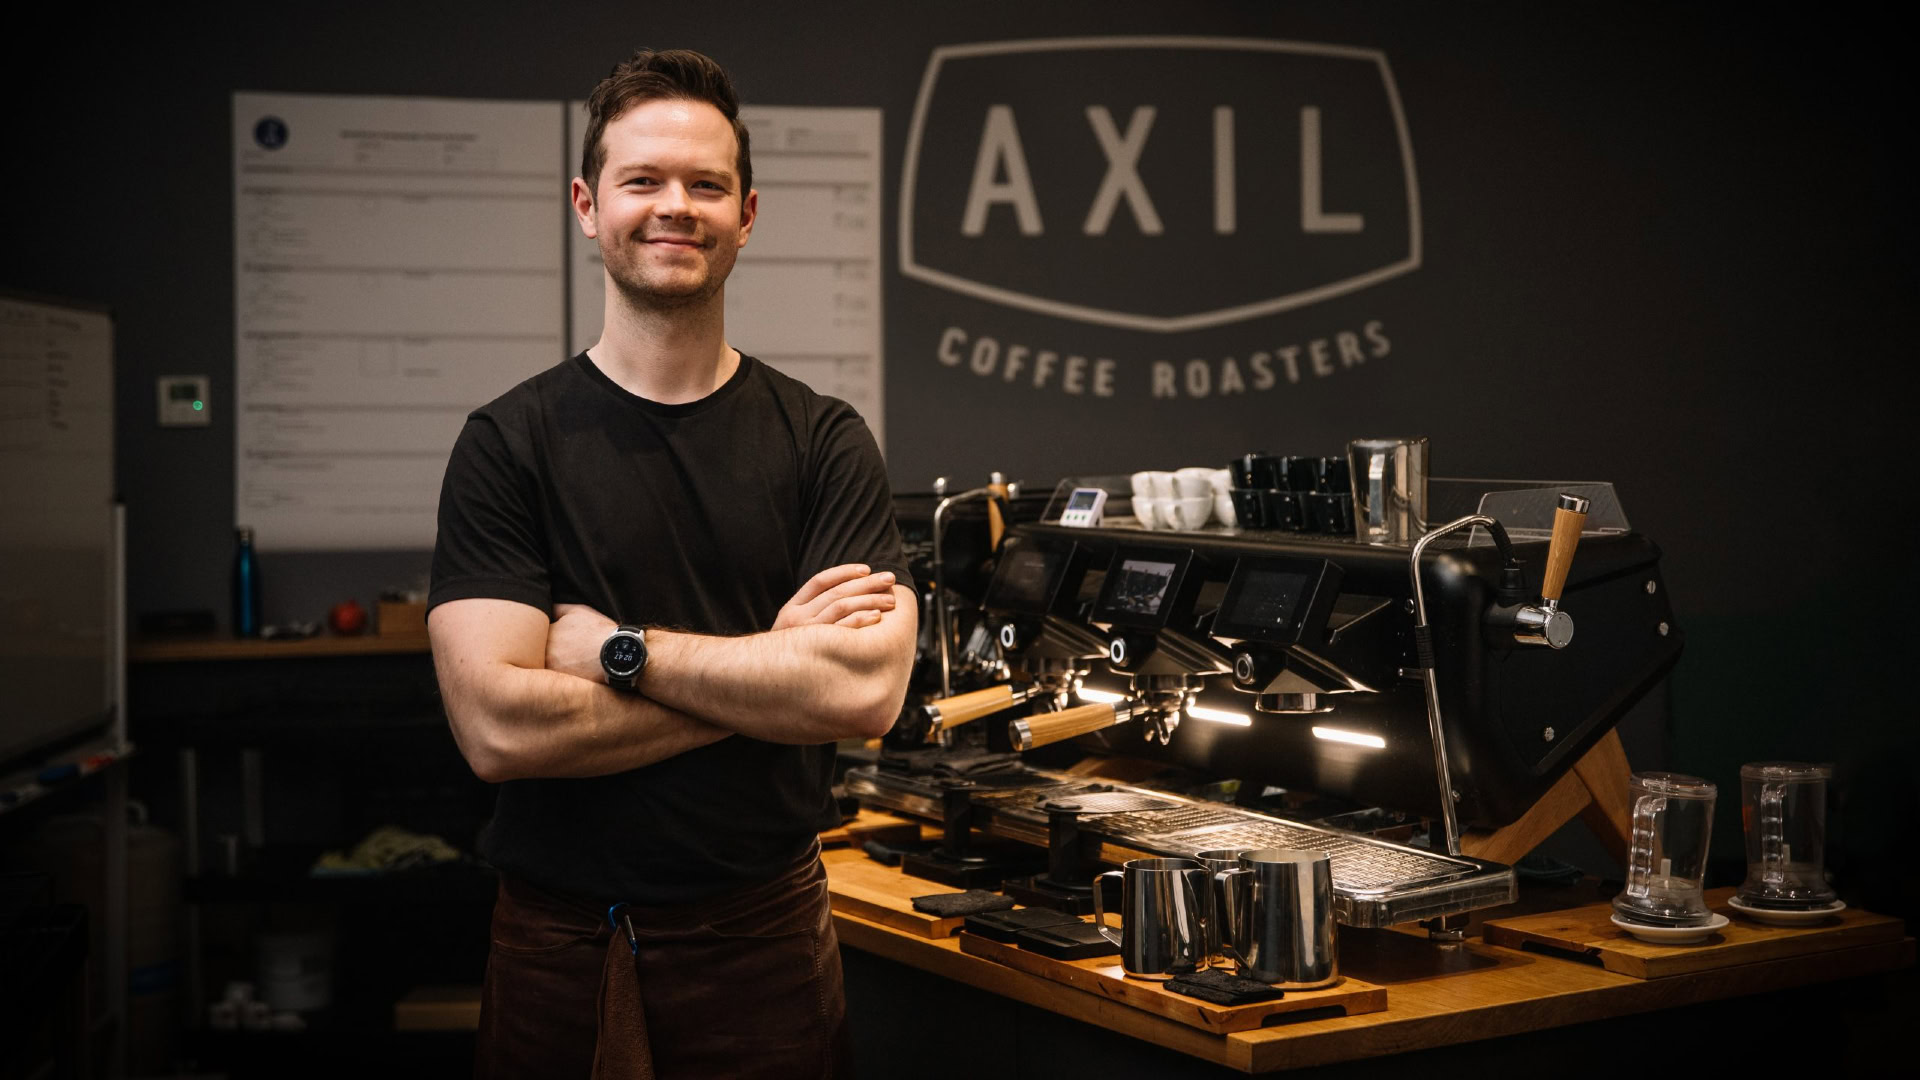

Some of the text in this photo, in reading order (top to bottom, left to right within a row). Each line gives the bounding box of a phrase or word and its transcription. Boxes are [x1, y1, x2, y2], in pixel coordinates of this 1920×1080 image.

[961, 105, 1364, 236] AXIL
[938, 326, 1116, 396] COFFEE
[1152, 321, 1391, 397] ROASTERS
